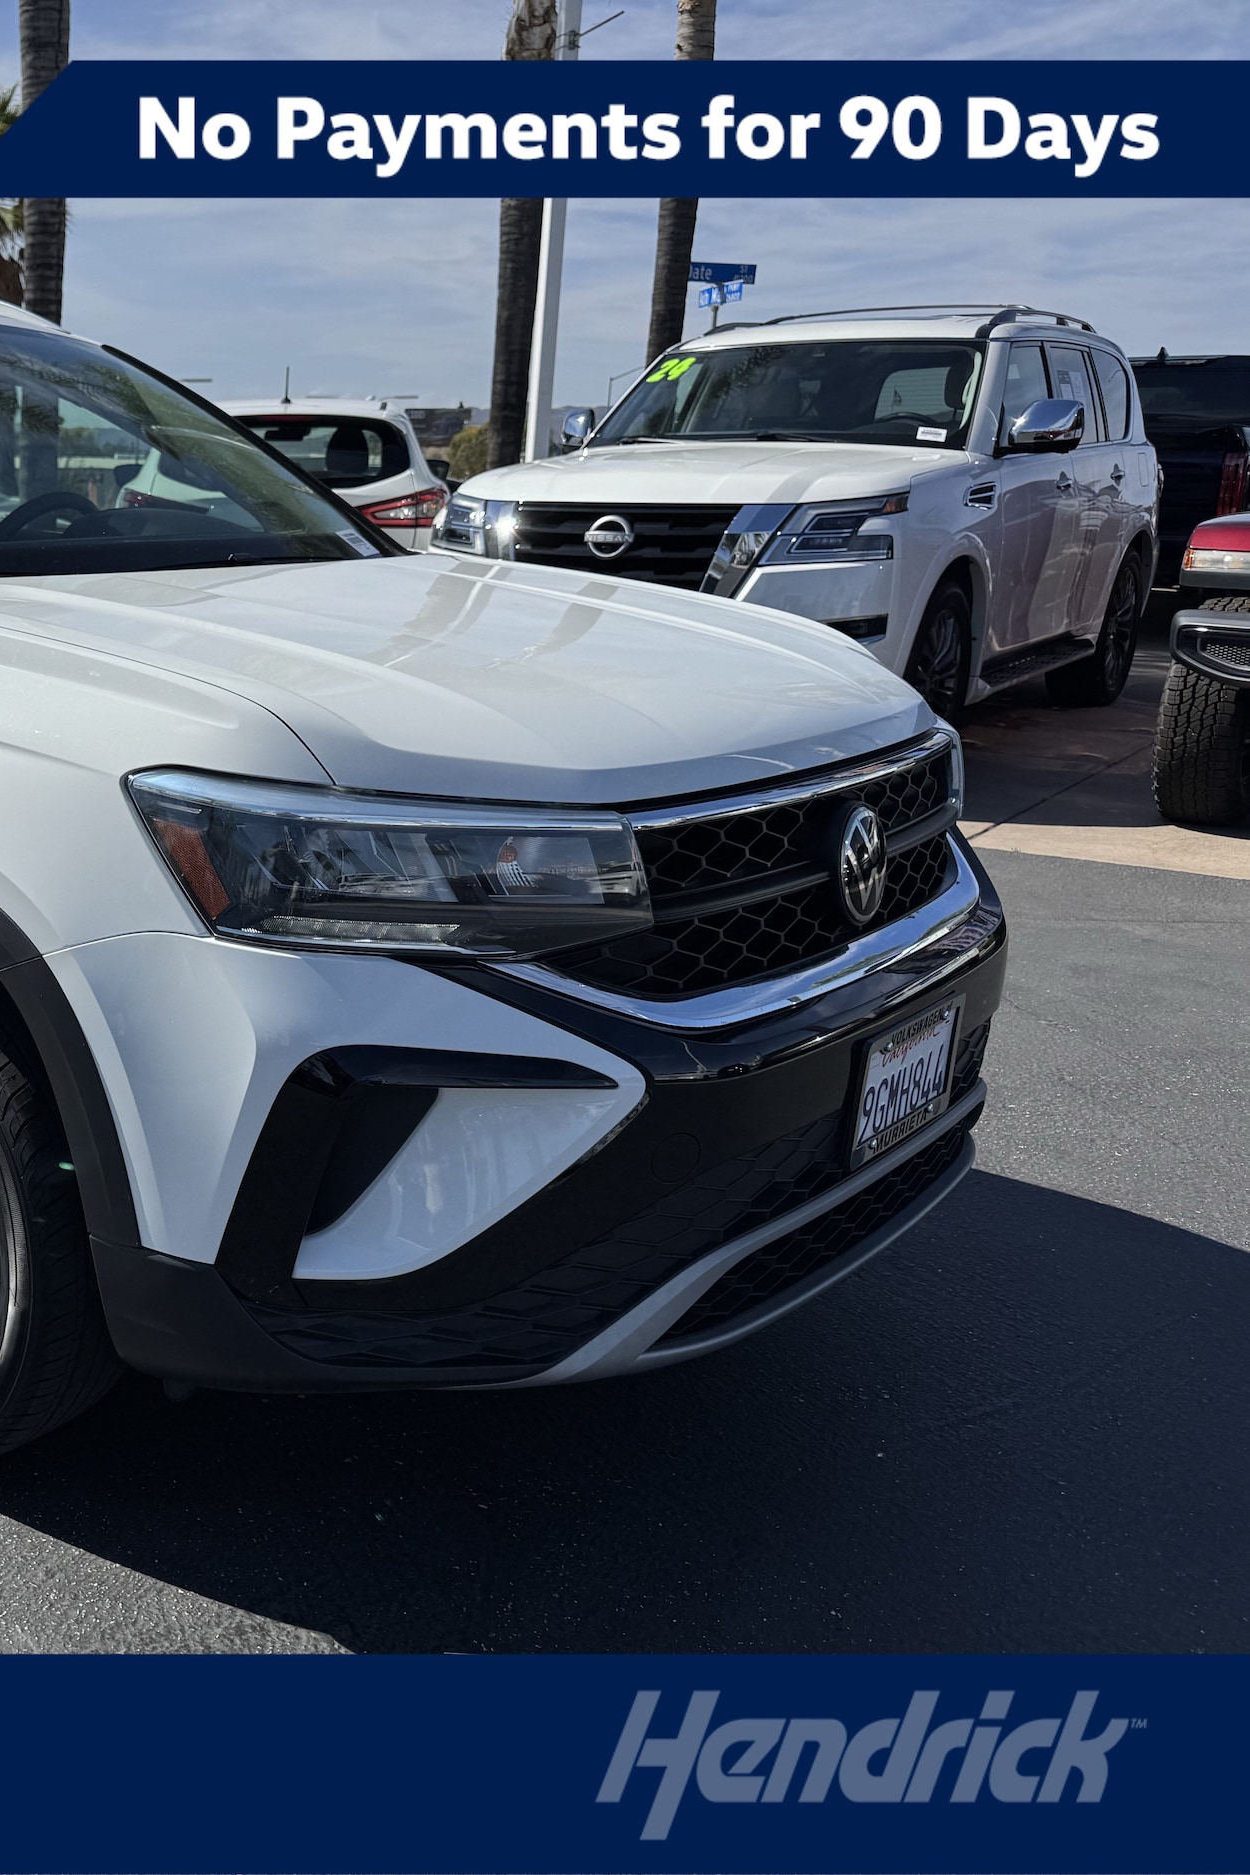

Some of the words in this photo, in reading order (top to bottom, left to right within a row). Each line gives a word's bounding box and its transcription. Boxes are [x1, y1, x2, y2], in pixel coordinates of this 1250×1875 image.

[585, 533, 632, 542] NISSAN
[858, 1043, 944, 1144] 9GMH844
[873, 1108, 928, 1154] MURRIETA
